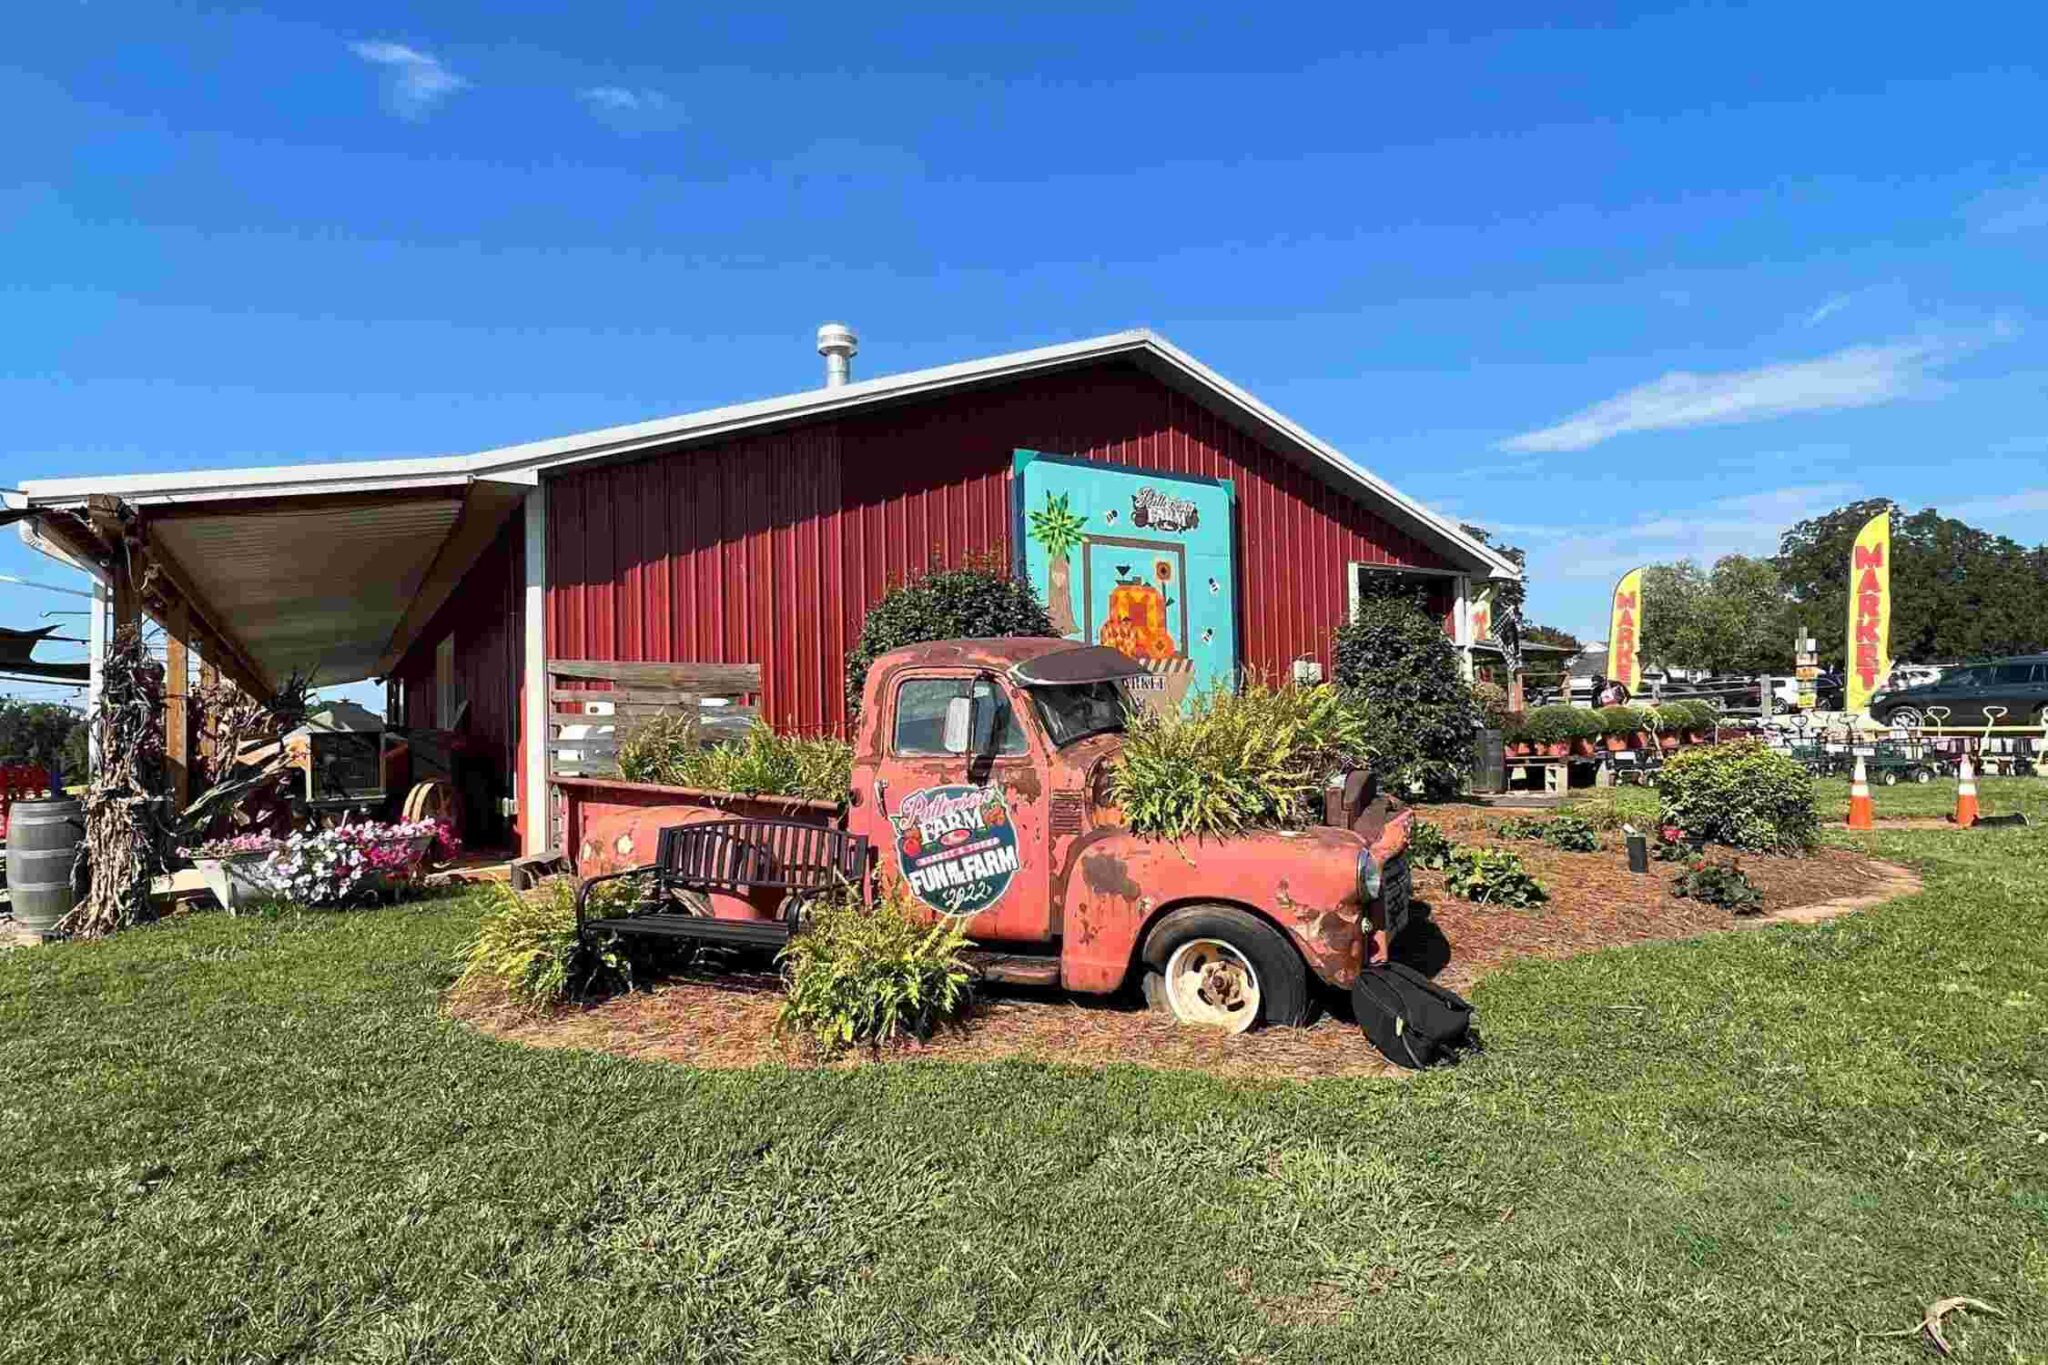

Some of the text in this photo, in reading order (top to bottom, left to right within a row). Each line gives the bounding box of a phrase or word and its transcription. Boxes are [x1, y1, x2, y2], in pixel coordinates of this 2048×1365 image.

[1616, 591, 1636, 686] MARKE
[1855, 542, 1884, 690] MARKET
[918, 807, 986, 846] FARM
[908, 862, 948, 895] FUN
[961, 845, 1018, 881] FARM
[944, 881, 988, 909] 2022
